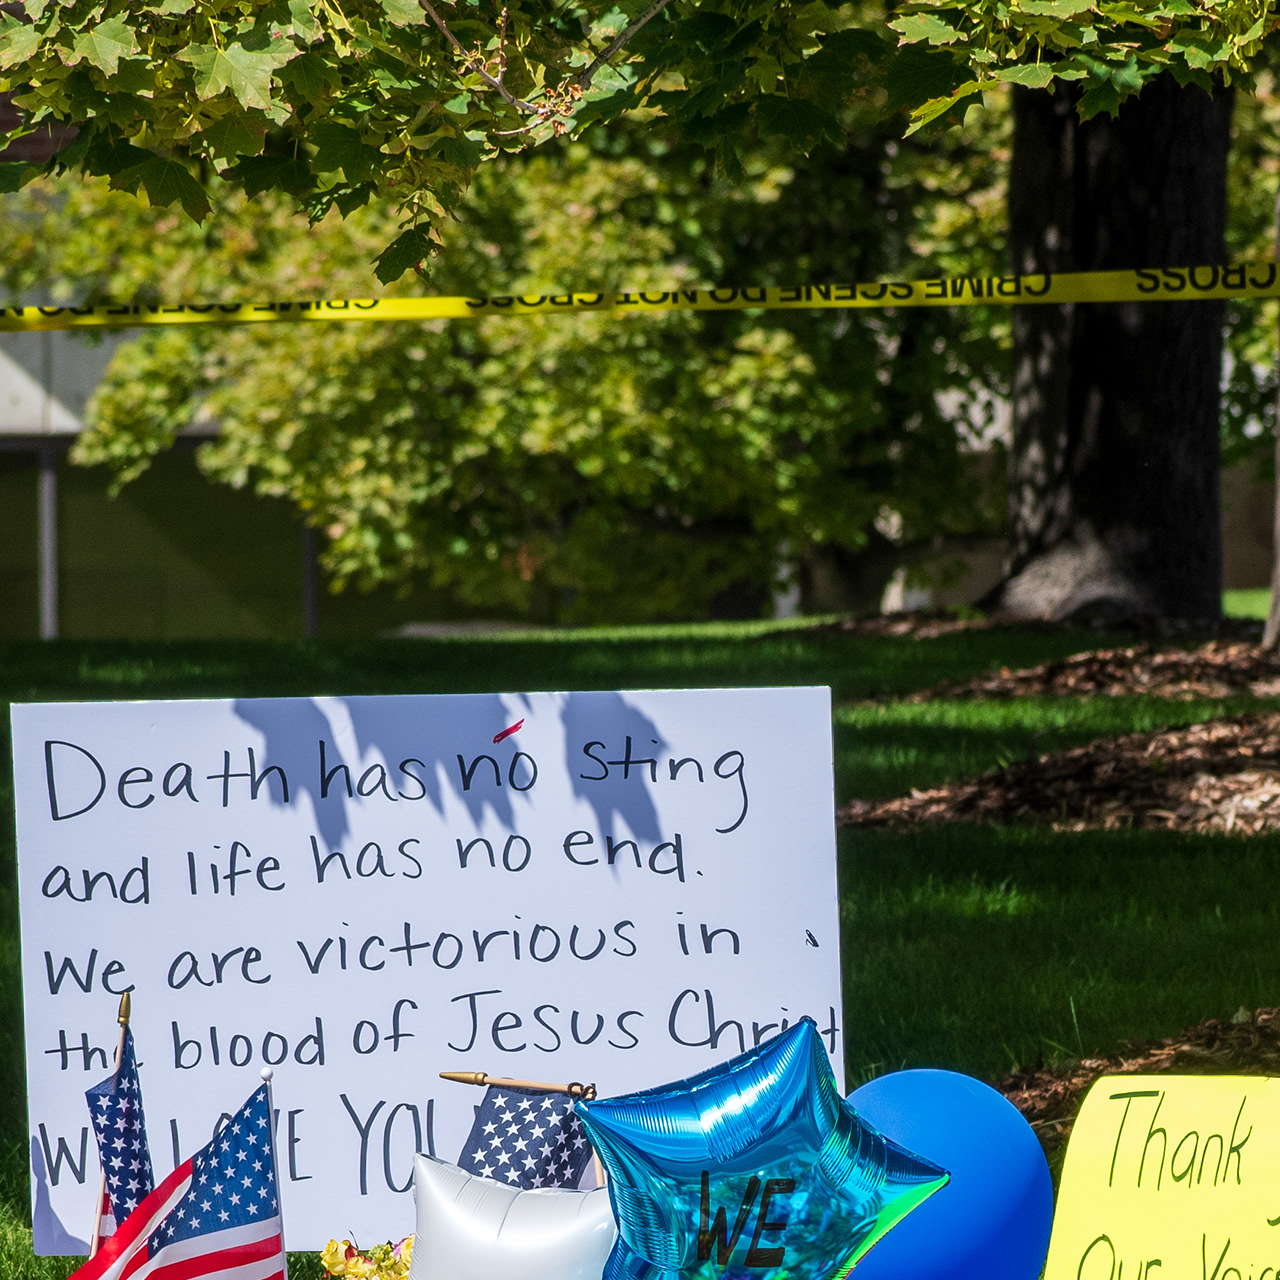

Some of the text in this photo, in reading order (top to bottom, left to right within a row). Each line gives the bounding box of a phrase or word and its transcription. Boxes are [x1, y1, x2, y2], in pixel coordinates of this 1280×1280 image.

[1136, 263, 1277, 294] CROSS
[44, 738, 291, 821] Death
[318, 739, 427, 802] has
[458, 744, 538, 793] no
[42, 829, 705, 905] and life has no end.
[166, 944, 272, 990] are
[297, 918, 637, 975] victorious
[676, 911, 740, 956] in
[173, 1015, 325, 1069] blood
[352, 999, 419, 1054] of
[447, 989, 644, 1053] Jesus
[668, 989, 840, 1054] Chrit
[1108, 1090, 1253, 1190] Thank
[697, 1169, 796, 1268] WE
